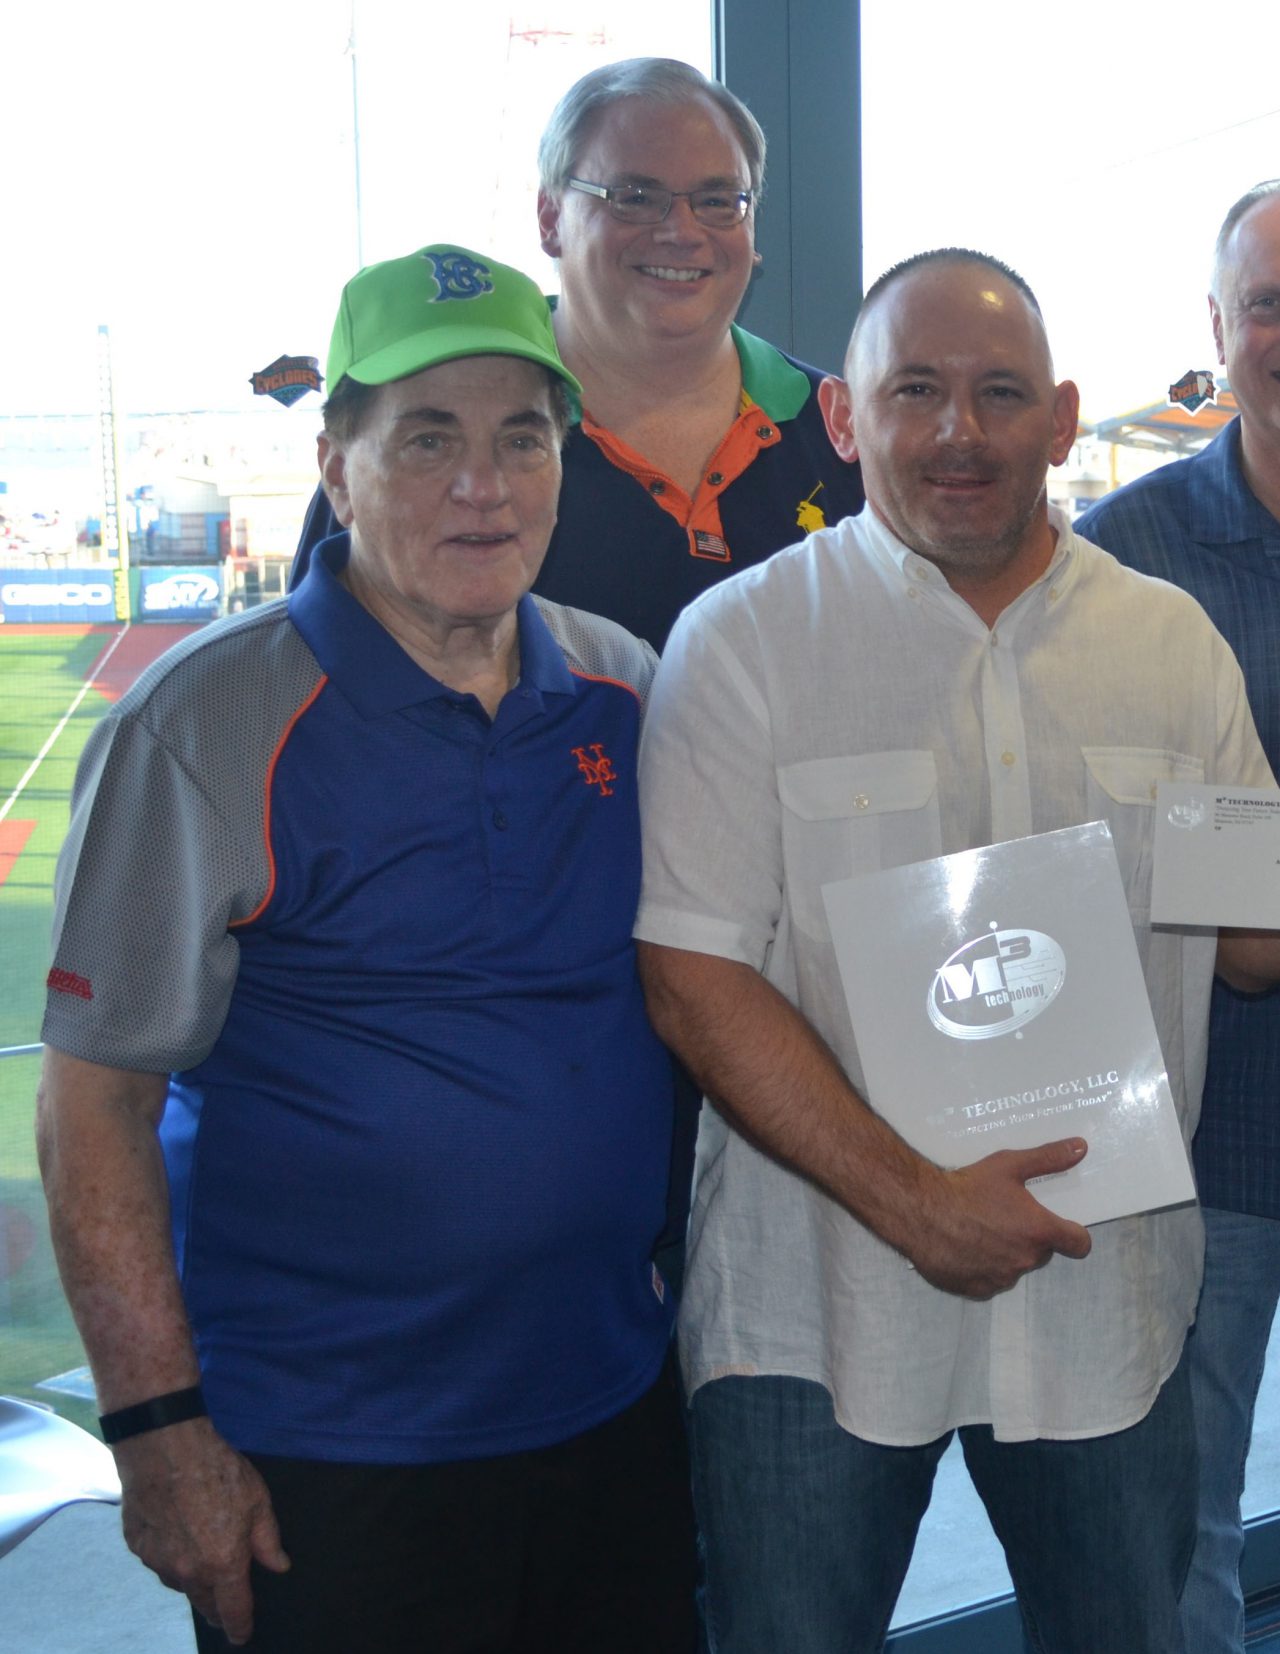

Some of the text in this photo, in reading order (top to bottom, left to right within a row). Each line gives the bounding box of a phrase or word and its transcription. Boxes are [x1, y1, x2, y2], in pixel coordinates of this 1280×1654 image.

[255, 368, 318, 394] CYCLONES
[571, 743, 617, 796] NY
[984, 983, 1045, 1008] technology
[961, 1078, 1084, 1119] TECHNOLOGY,
[1086, 1070, 1119, 1089] LLC
